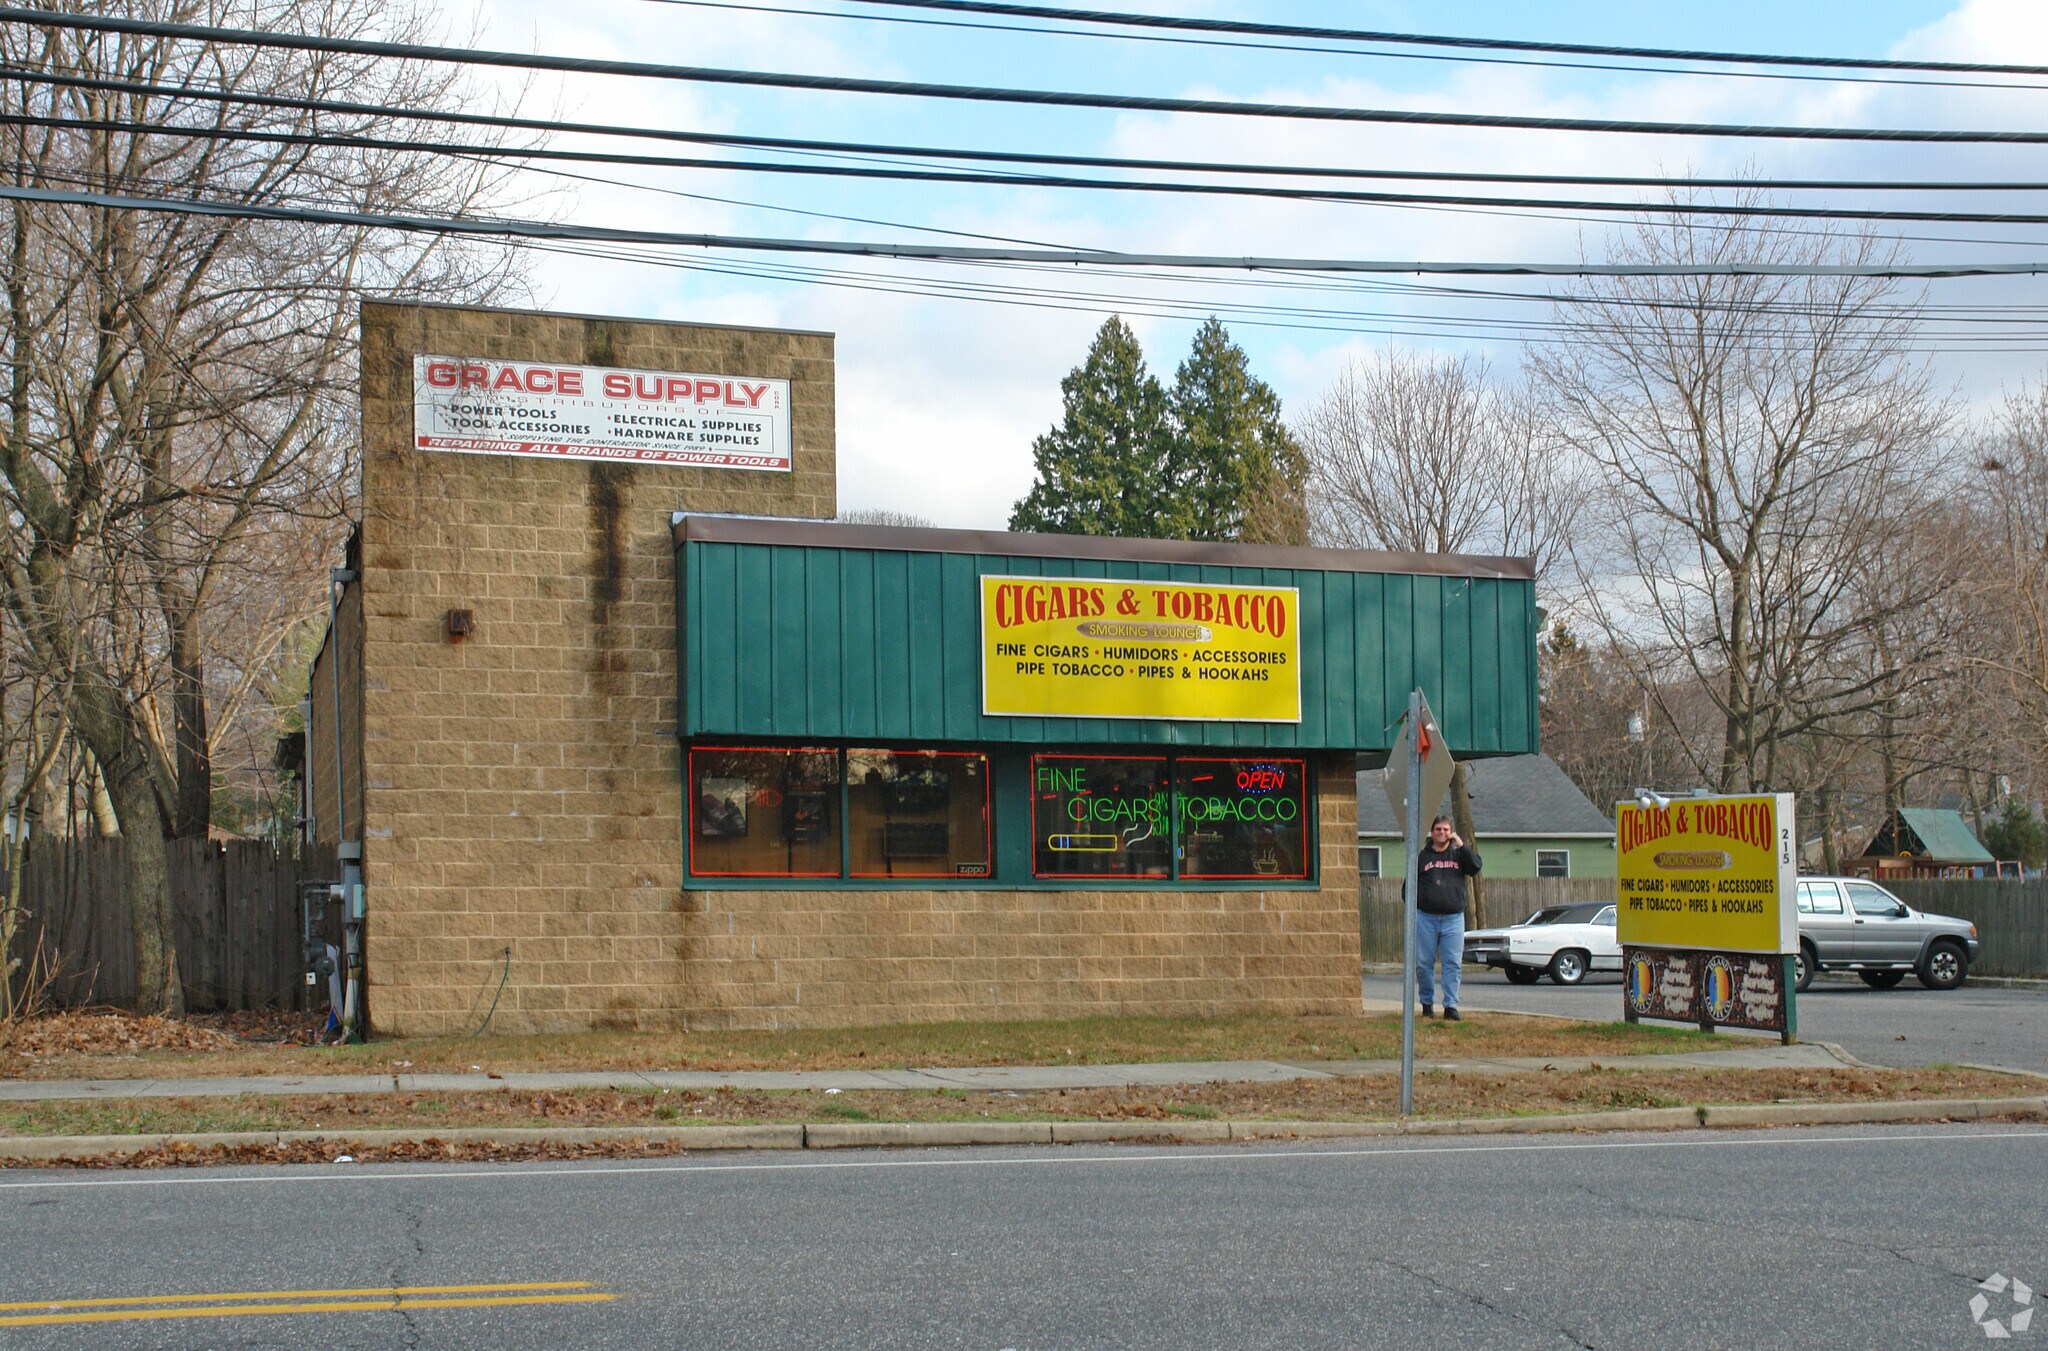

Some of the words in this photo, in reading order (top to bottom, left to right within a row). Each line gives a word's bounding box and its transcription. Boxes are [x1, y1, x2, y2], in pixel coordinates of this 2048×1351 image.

[426, 362, 583, 397] GRACE
[603, 372, 770, 409] SUPPLY
[451, 404, 503, 417] POWER
[509, 407, 557, 419] TOOLS
[486, 394, 685, 414] DISTRIBUTORS
[698, 407, 724, 416] OF
[451, 418, 492, 429] TOOL
[498, 420, 591, 434] ACCESSORIES
[614, 414, 696, 429] ELECTRICAL
[702, 420, 762, 432] SUPPLIES
[507, 434, 563, 443] SUPPLYING
[586, 438, 650, 448] CONTRACTOR
[652, 442, 682, 450] SINCE
[614, 428, 694, 441] HARDWARE
[700, 433, 760, 446] SUPPLIES
[428, 438, 522, 451] REPAIRING
[529, 444, 561, 454] ALL
[566, 447, 637, 457] BRANDS
[641, 451, 663, 460] OF
[665, 452, 727, 463] POWER
[729, 455, 780, 467] TOOLS
[995, 583, 1105, 629] CIGARS
[1116, 588, 1141, 615] &
[1152, 589, 1286, 639] TOBACCO
[1089, 623, 1148, 638] SMOKING
[1154, 625, 1201, 640] LOUNGE
[996, 643, 1026, 657] FINE
[1033, 644, 1089, 659] CIGARS
[1103, 646, 1179, 661] HUMIDORS
[1192, 649, 1287, 664] ACCESSORIES
[1016, 662, 1045, 675] PIPE
[1053, 663, 1124, 677] TOBACCO
[1138, 665, 1174, 679] PIPES
[1182, 666, 1191, 679] &
[1199, 667, 1269, 681] HOOKAHS
[1037, 767, 1086, 793] FINE
[1237, 771, 1285, 790] OPEN
[1067, 797, 1161, 823] CIGARS
[1179, 797, 1297, 822] TOBACCO
[1621, 806, 1671, 854] CIGARS
[1676, 804, 1689, 834] &
[1694, 802, 1772, 852] TOBACCO
[1659, 855, 1692, 866] SMOKING
[1621, 877, 1635, 892] FINE
[1637, 878, 1664, 892] CIGARS
[1670, 878, 1710, 893] HUMIDORS
[1717, 878, 1774, 894] ACCESSORIES
[1629, 896, 1643, 911] PIPE
[1646, 897, 1682, 912] TOBACCO
[1688, 898, 1708, 913] PIPES
[1711, 899, 1718, 913] &
[1721, 899, 1763, 914] HOOKAHS
[1632, 954, 1652, 967] ISLAND
[1709, 958, 1729, 972] ISLAND
